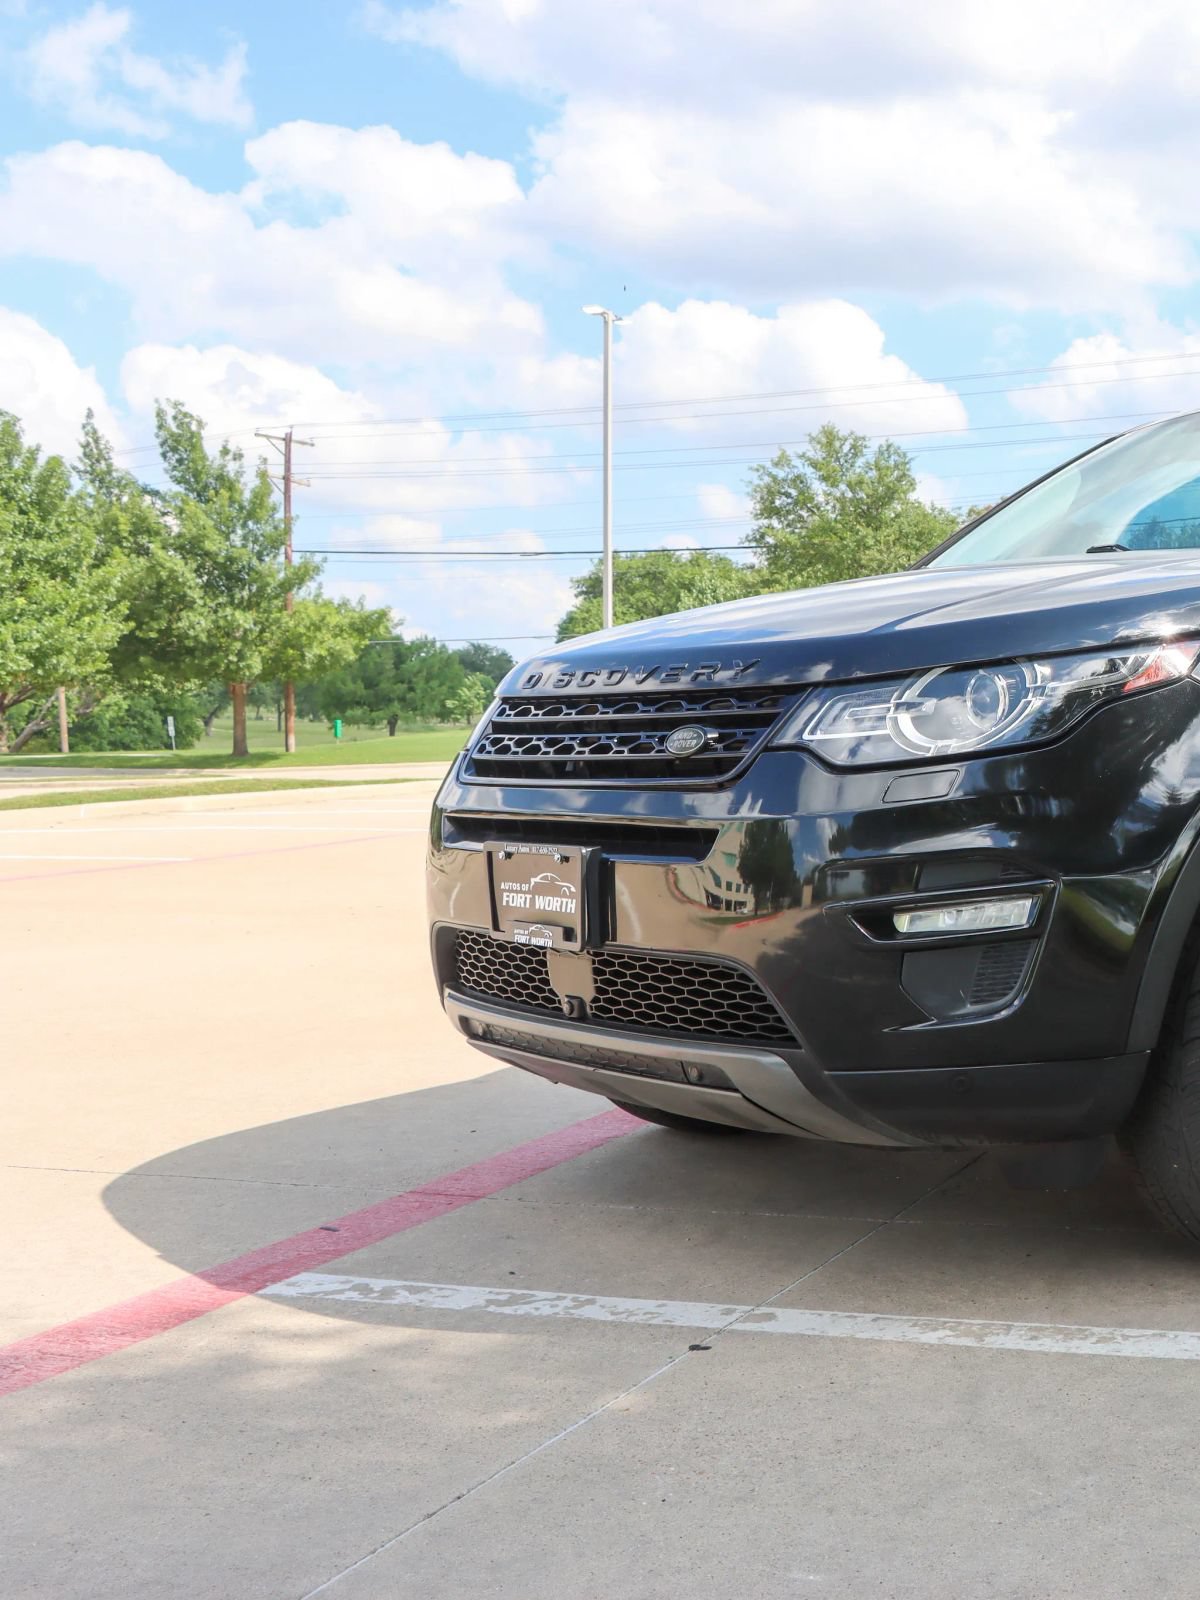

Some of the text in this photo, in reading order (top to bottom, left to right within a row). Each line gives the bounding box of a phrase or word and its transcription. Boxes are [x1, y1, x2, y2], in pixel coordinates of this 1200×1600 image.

[521, 658, 761, 689] DISCOVERY
[672, 739, 697, 749] ROVER
[501, 882, 529, 892] AUTOS OF
[502, 892, 577, 914] FORT WORTH
[514, 934, 553, 948] FORT WORTH
